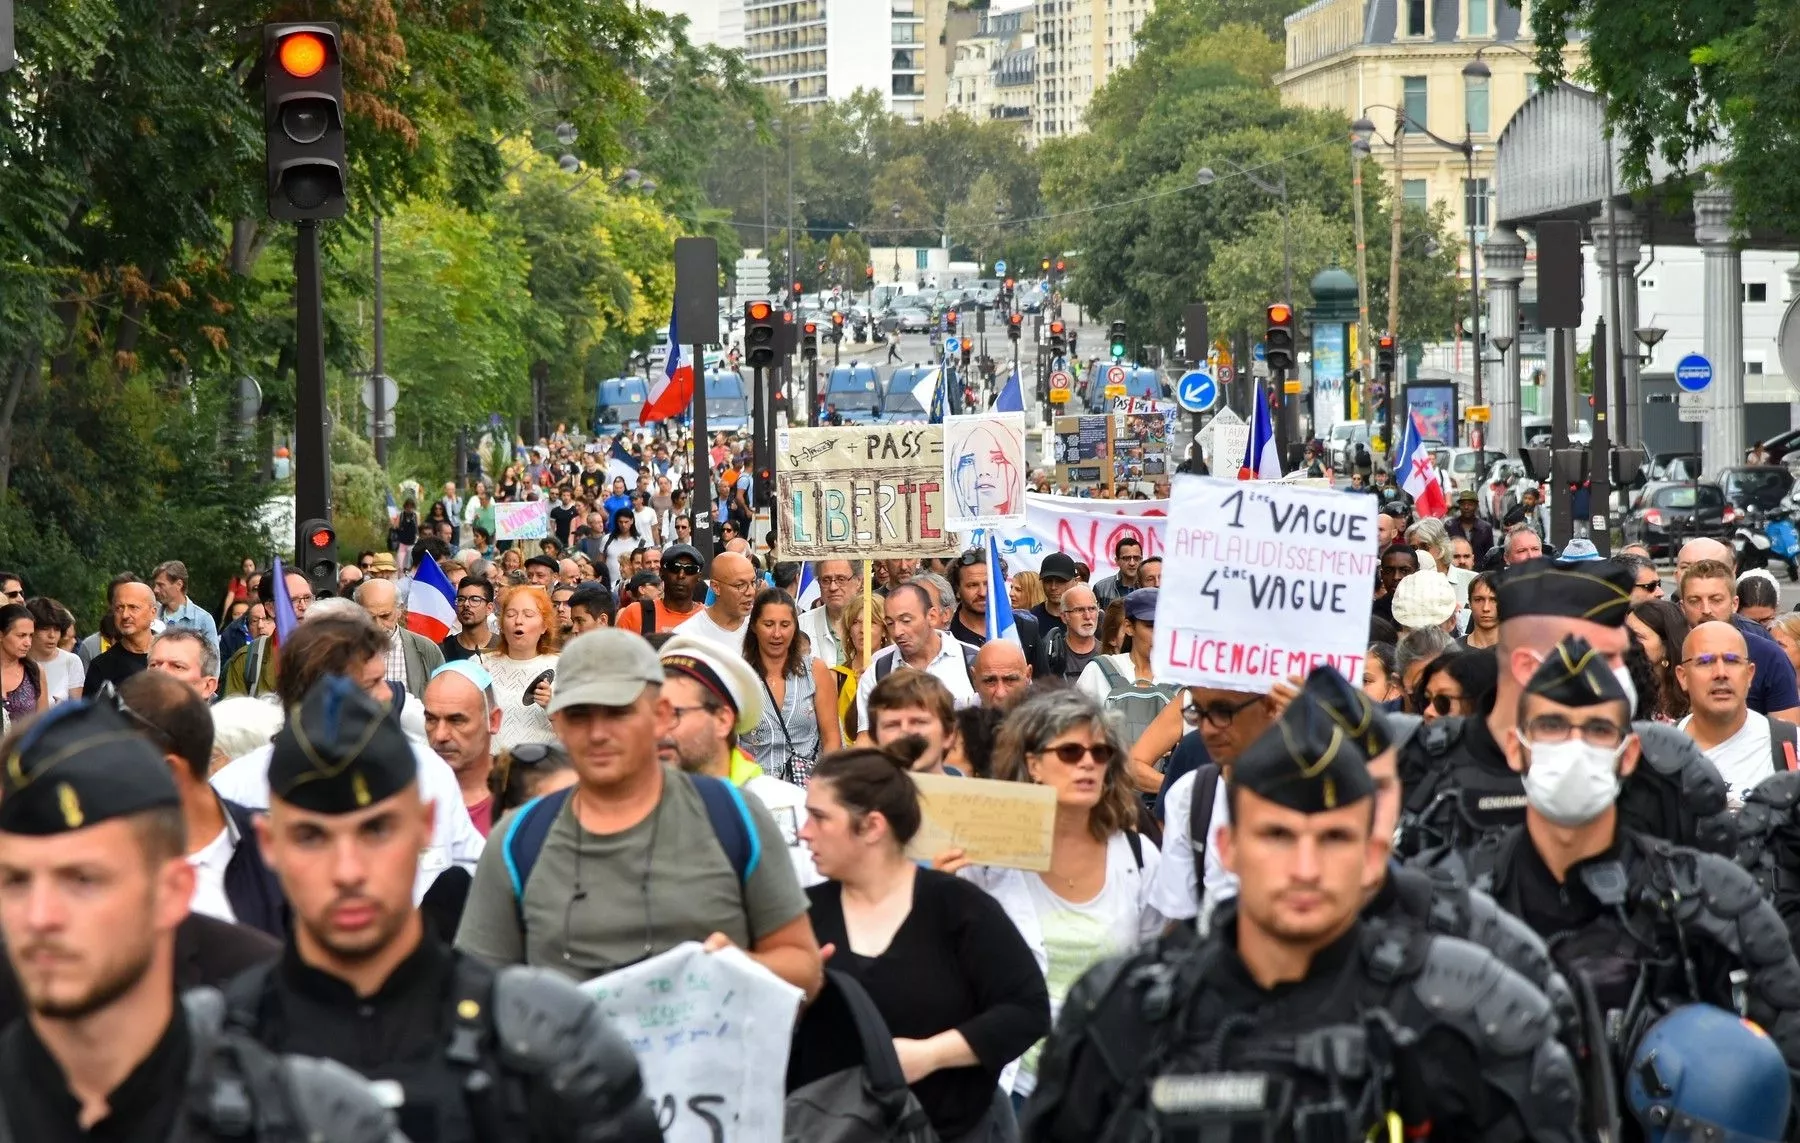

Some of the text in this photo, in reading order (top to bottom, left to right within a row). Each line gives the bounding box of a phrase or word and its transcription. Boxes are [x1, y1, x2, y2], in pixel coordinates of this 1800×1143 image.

[866, 430, 927, 460] PASS
[1269, 500, 1369, 542] VAGUE
[1248, 574, 1348, 614] VAGUE
